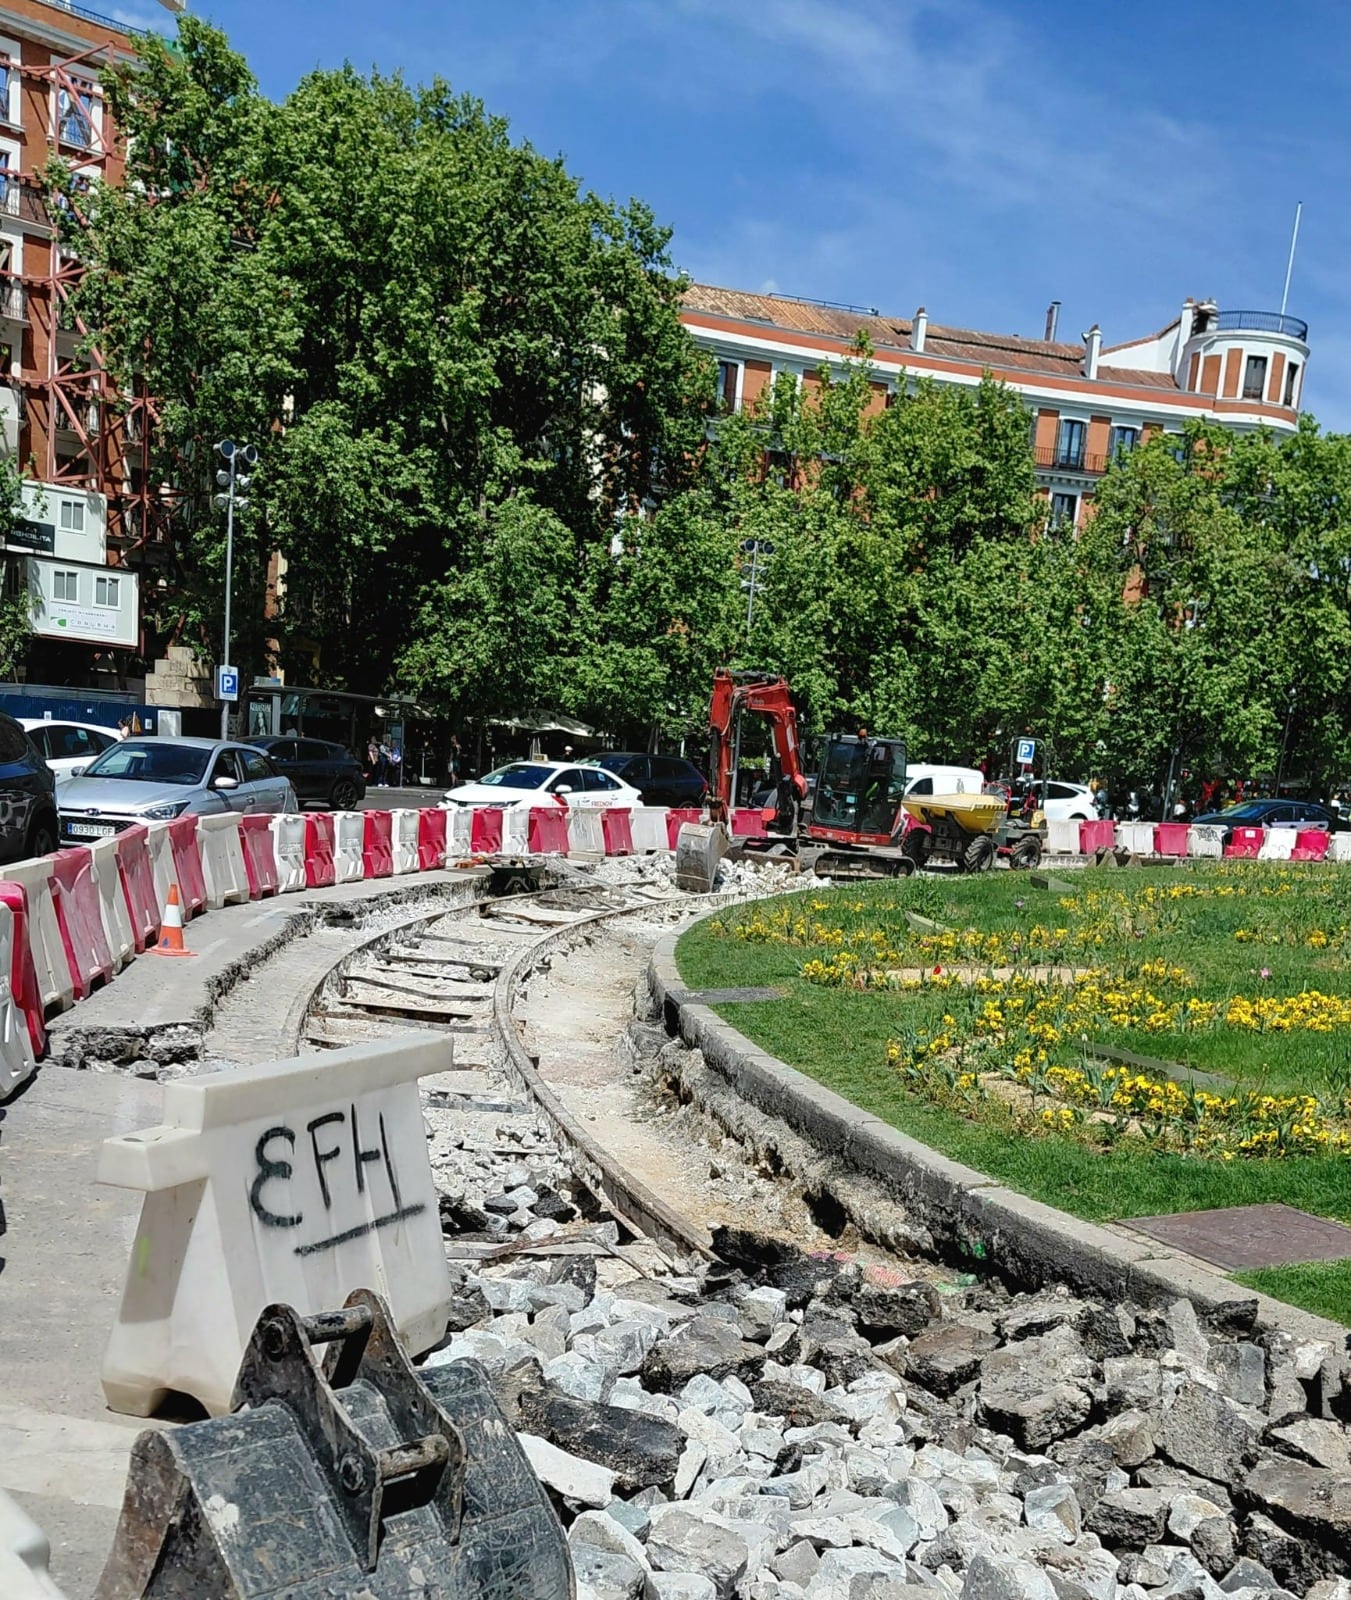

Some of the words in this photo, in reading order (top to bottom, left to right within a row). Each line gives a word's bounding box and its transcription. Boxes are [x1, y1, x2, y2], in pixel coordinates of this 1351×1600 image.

[223, 675, 233, 691] P
[1021, 744, 1030, 756] P
[249, 1102, 404, 1229] EFH
